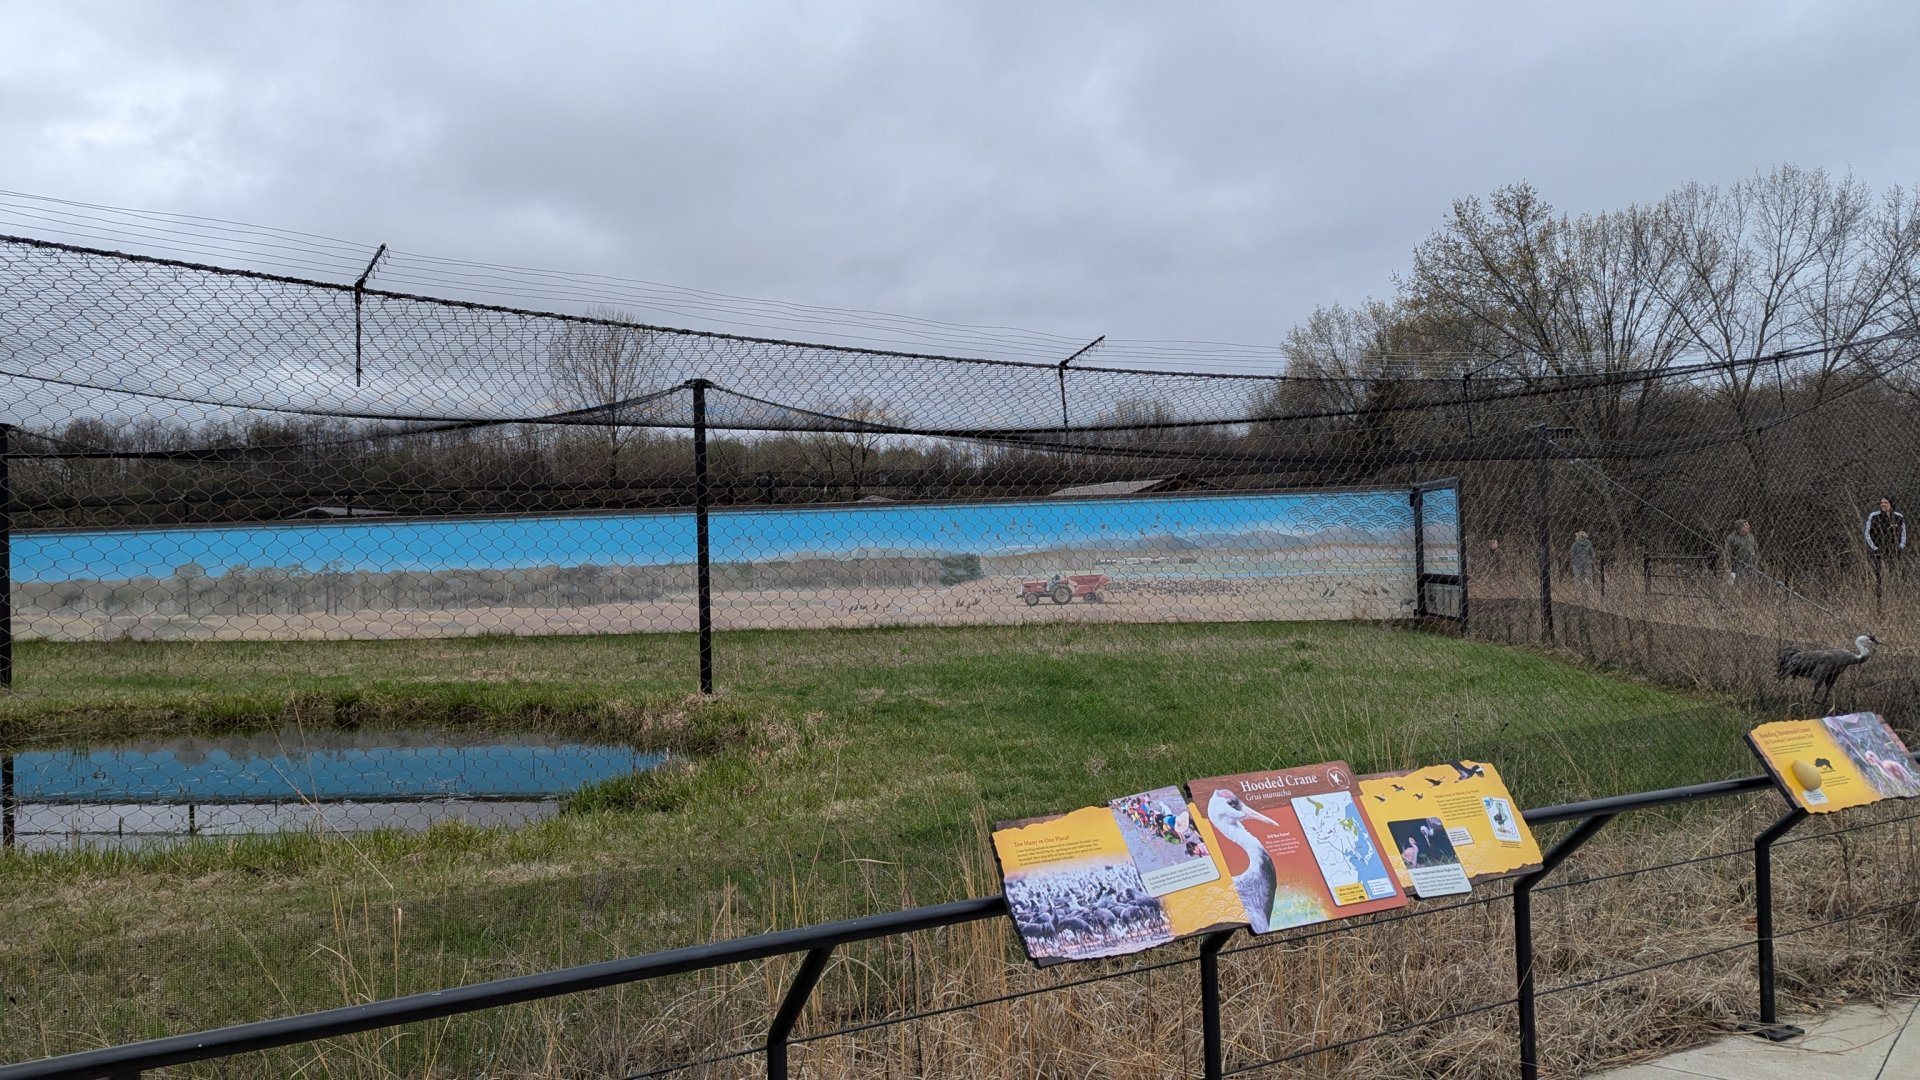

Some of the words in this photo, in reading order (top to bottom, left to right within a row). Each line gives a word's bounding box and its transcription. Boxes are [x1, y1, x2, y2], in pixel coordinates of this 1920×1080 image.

[1240, 776, 1285, 792] Hooded
[1285, 774, 1319, 786] Crane
[1245, 792, 1262, 802] Grus
[1262, 789, 1292, 799] monacha
[1024, 839, 1038, 847] Many
[1055, 834, 1070, 842] Place?
